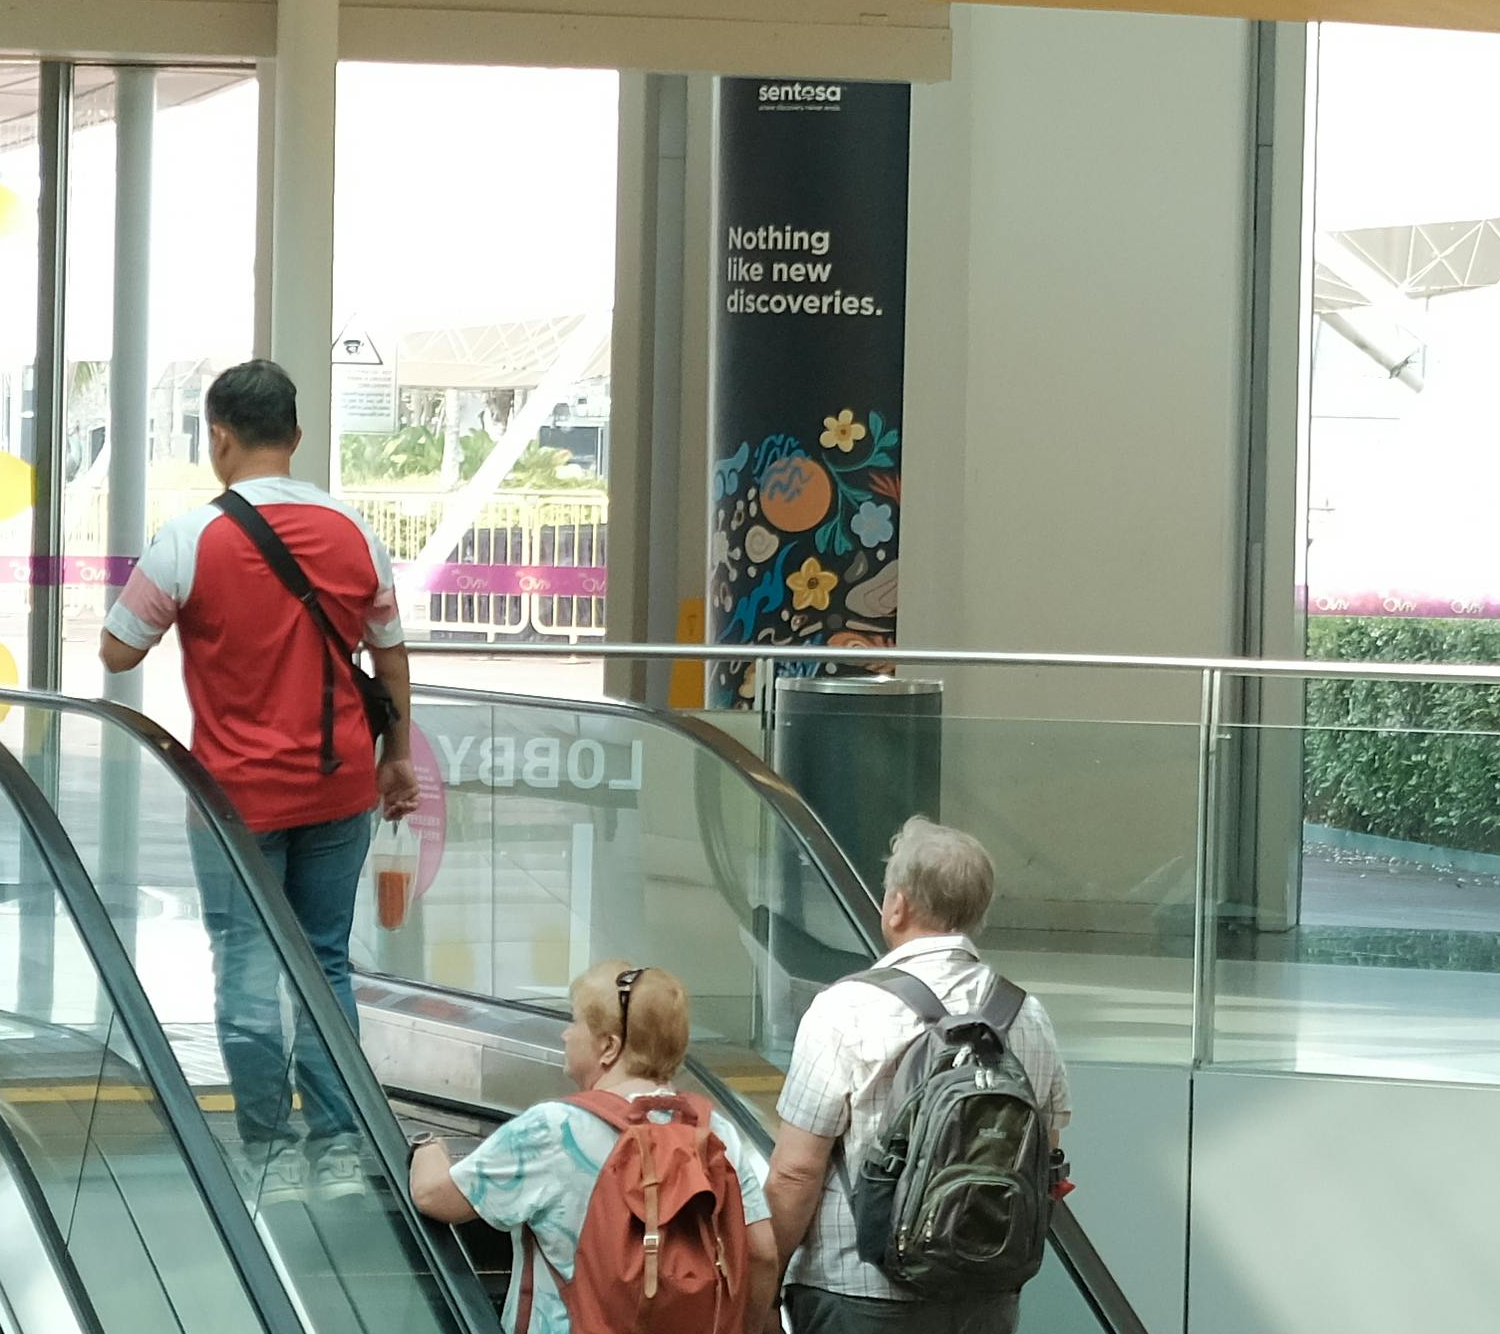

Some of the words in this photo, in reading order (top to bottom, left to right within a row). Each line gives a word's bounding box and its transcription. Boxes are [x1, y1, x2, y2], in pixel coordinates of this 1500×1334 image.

[758, 82, 841, 101] sentosa
[728, 225, 830, 255] Nothing
[727, 256, 764, 282] like
[772, 261, 832, 283] new
[726, 288, 884, 316] discoveries.
